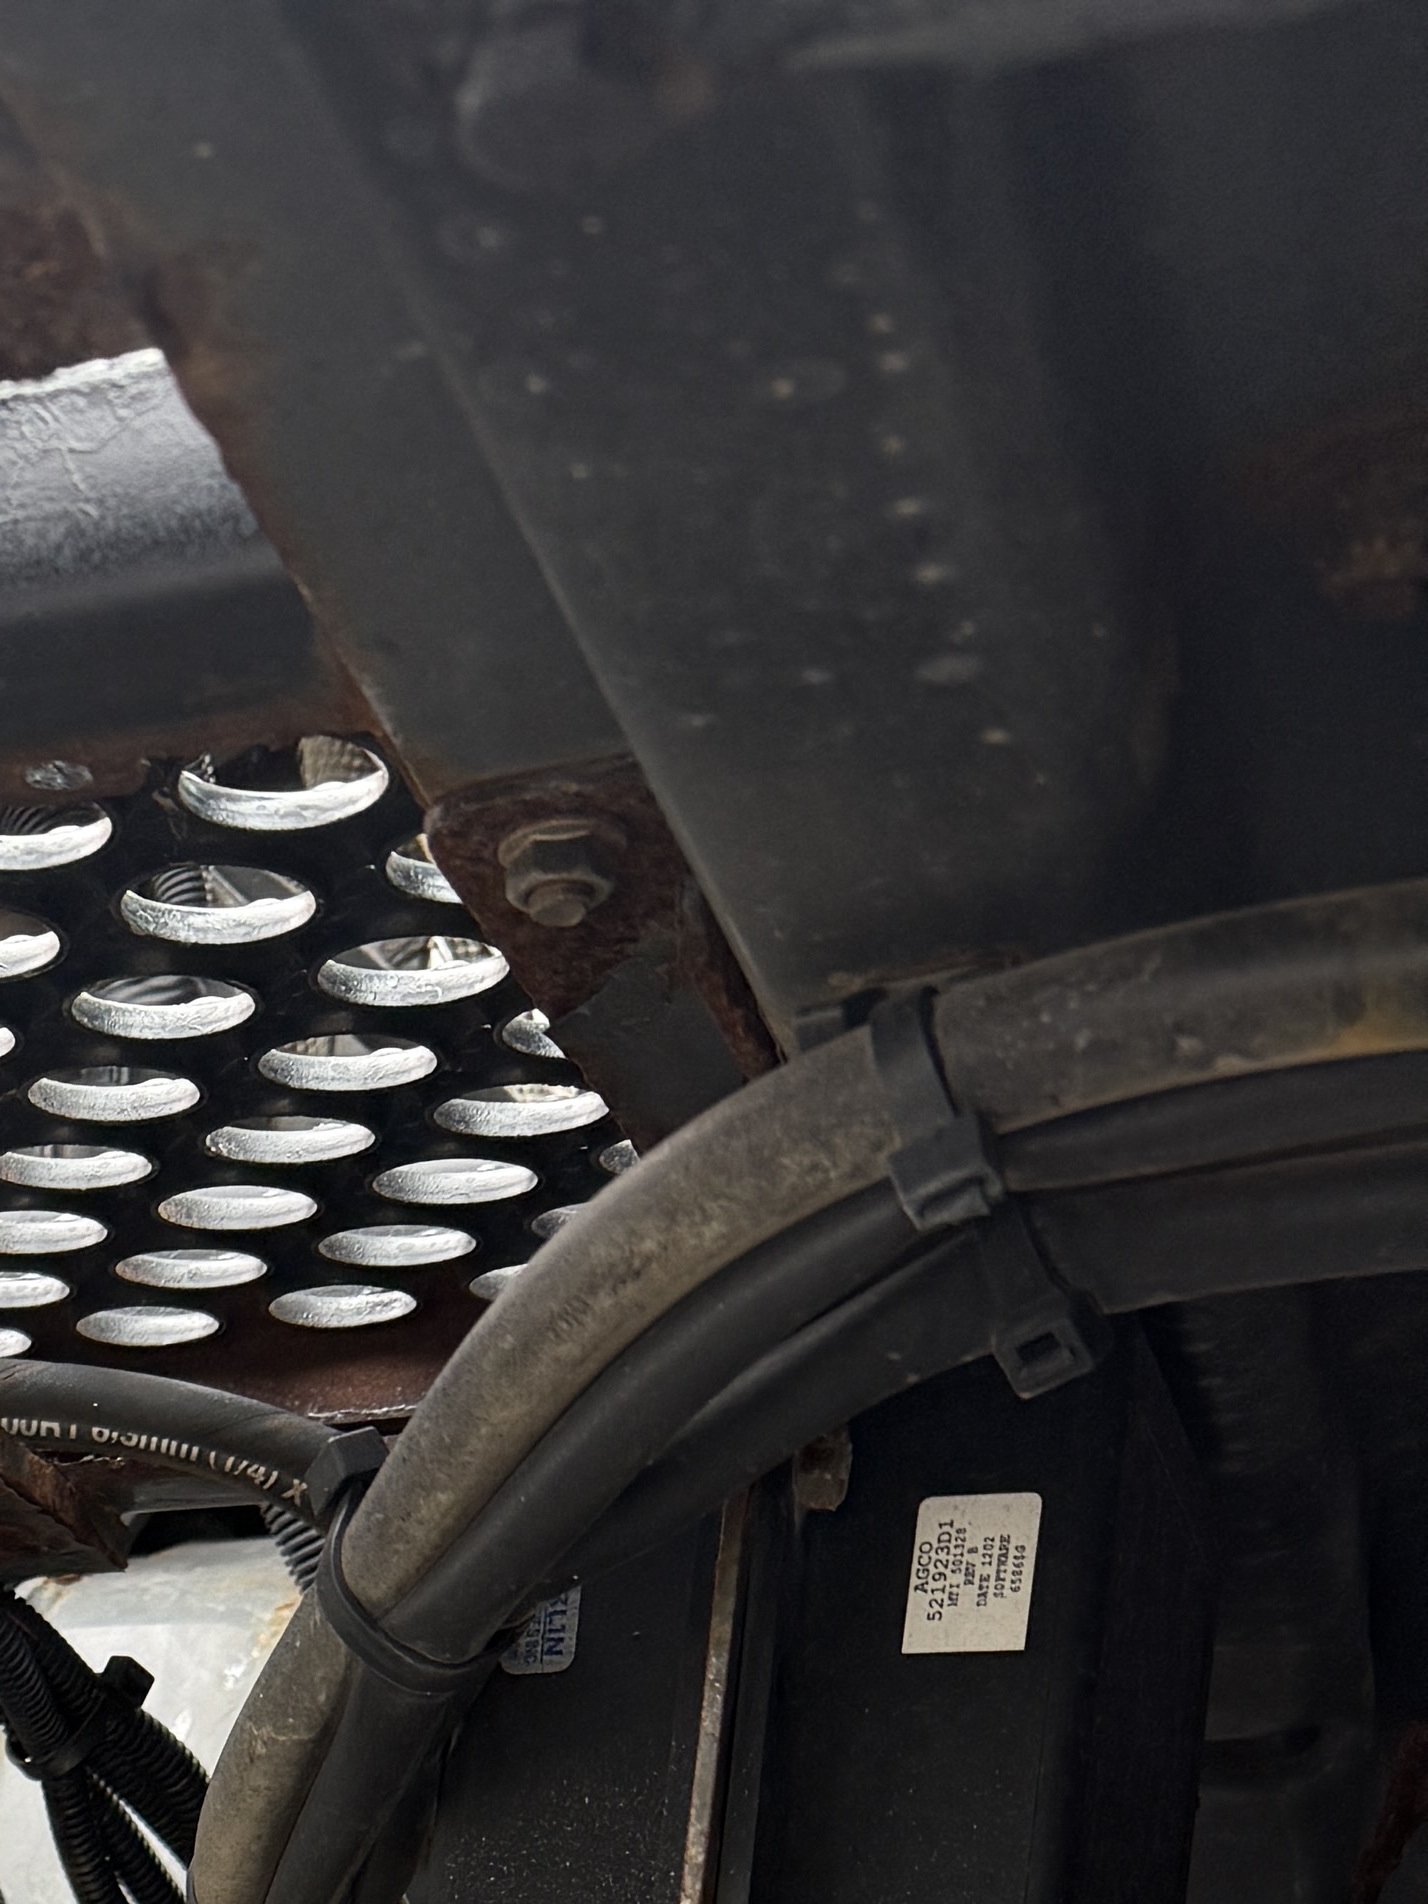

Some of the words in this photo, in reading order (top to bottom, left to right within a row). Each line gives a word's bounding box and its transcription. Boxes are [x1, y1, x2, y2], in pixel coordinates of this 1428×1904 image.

[914, 1541, 933, 1594] AGCO
[927, 1519, 954, 1621] 521923D1
[976, 1574, 990, 1607] DATE
[994, 1534, 1010, 1598] SOFTWARE
